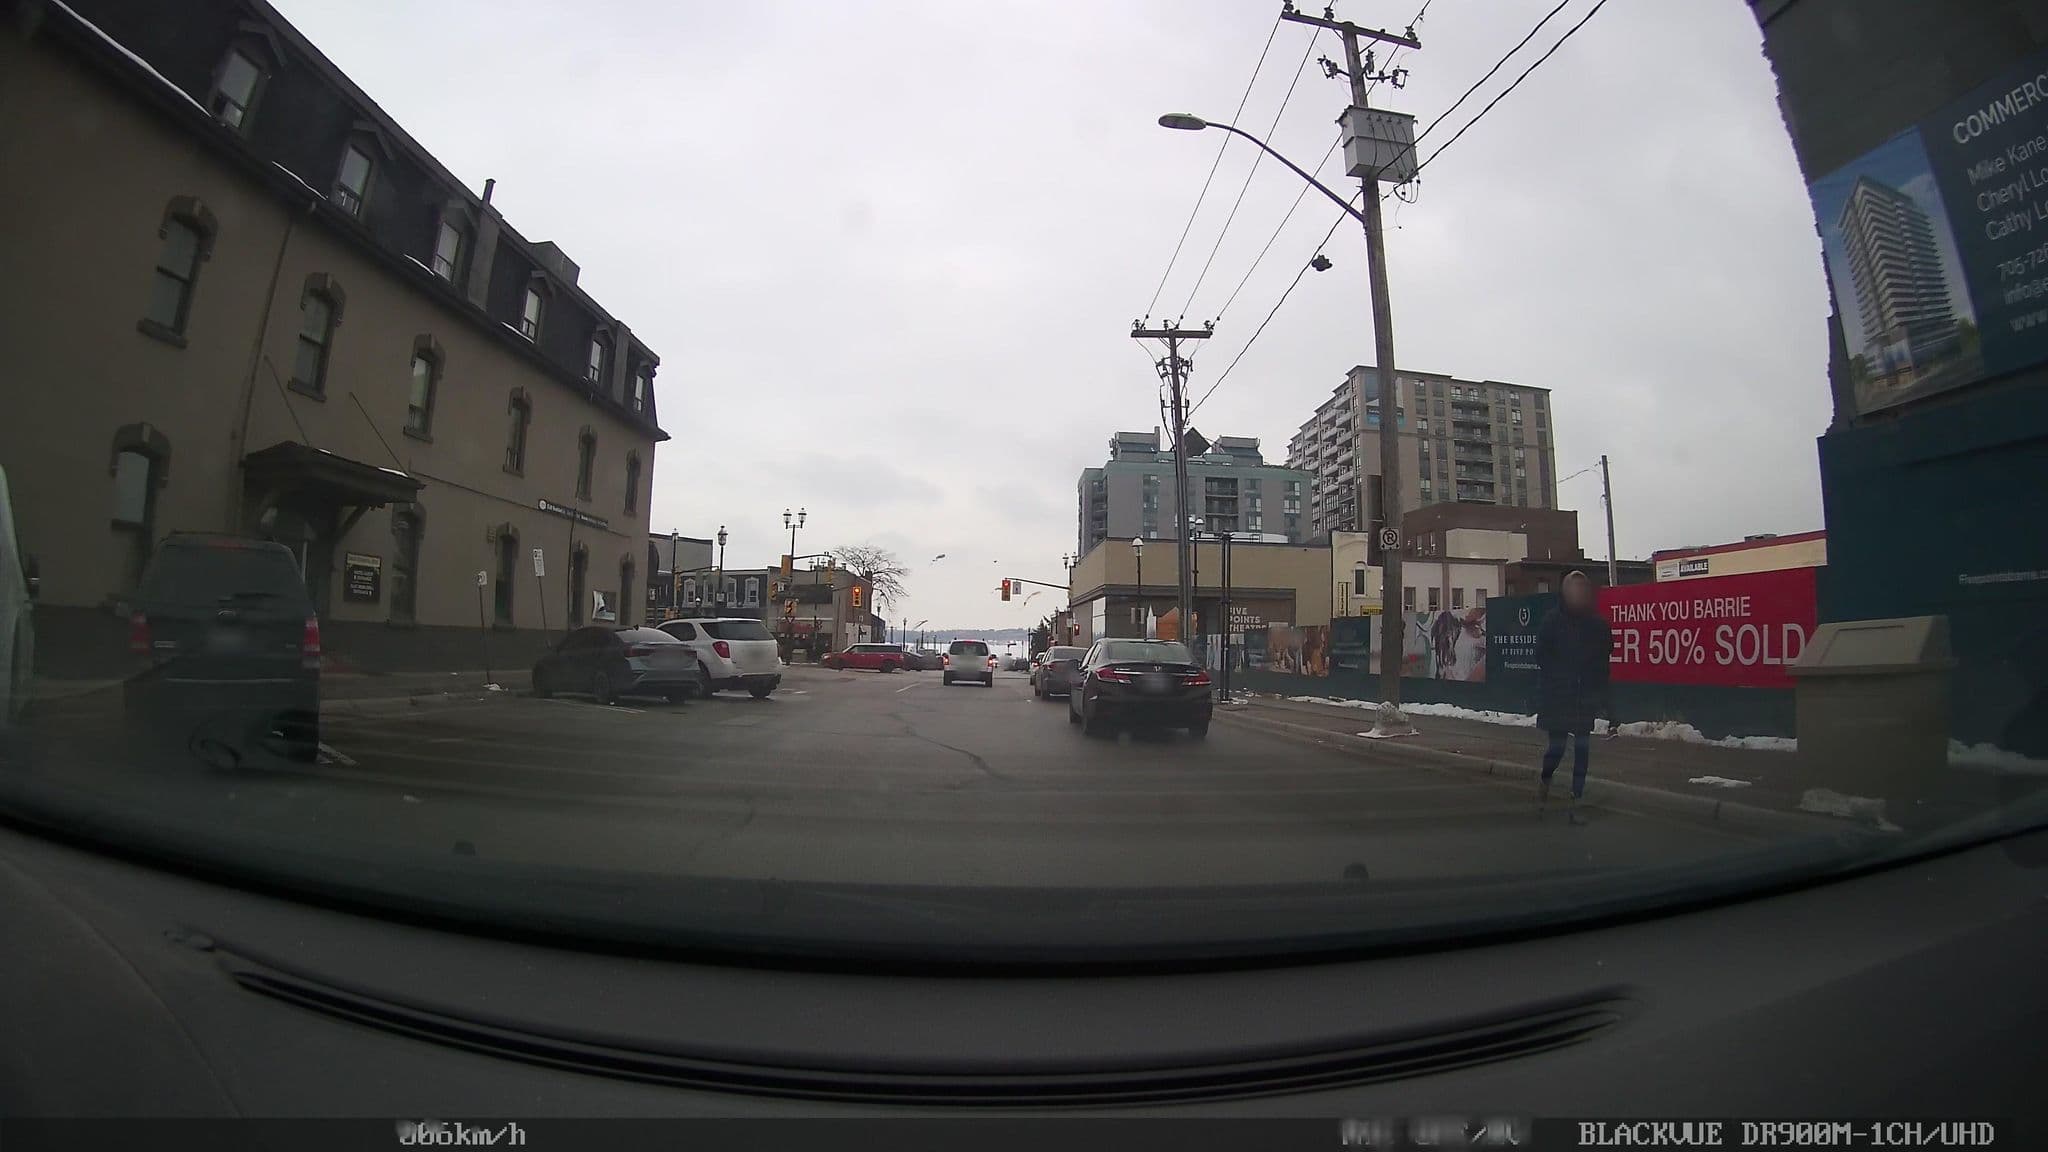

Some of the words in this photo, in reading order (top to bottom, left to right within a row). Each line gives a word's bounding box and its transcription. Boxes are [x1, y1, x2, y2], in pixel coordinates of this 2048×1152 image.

[1967, 156, 2007, 185] Mike
[2006, 135, 2046, 165] Kane
[1977, 172, 2031, 212] Cheryl
[1985, 208, 2032, 240] Cathy
[1611, 603, 1656, 622] THANK
[1659, 600, 1689, 621] YOU
[1694, 596, 1750, 619] BARRIE
[1494, 635, 1508, 644] THE
[1648, 627, 1705, 665] 50%
[1714, 623, 1806, 665] SOLD
